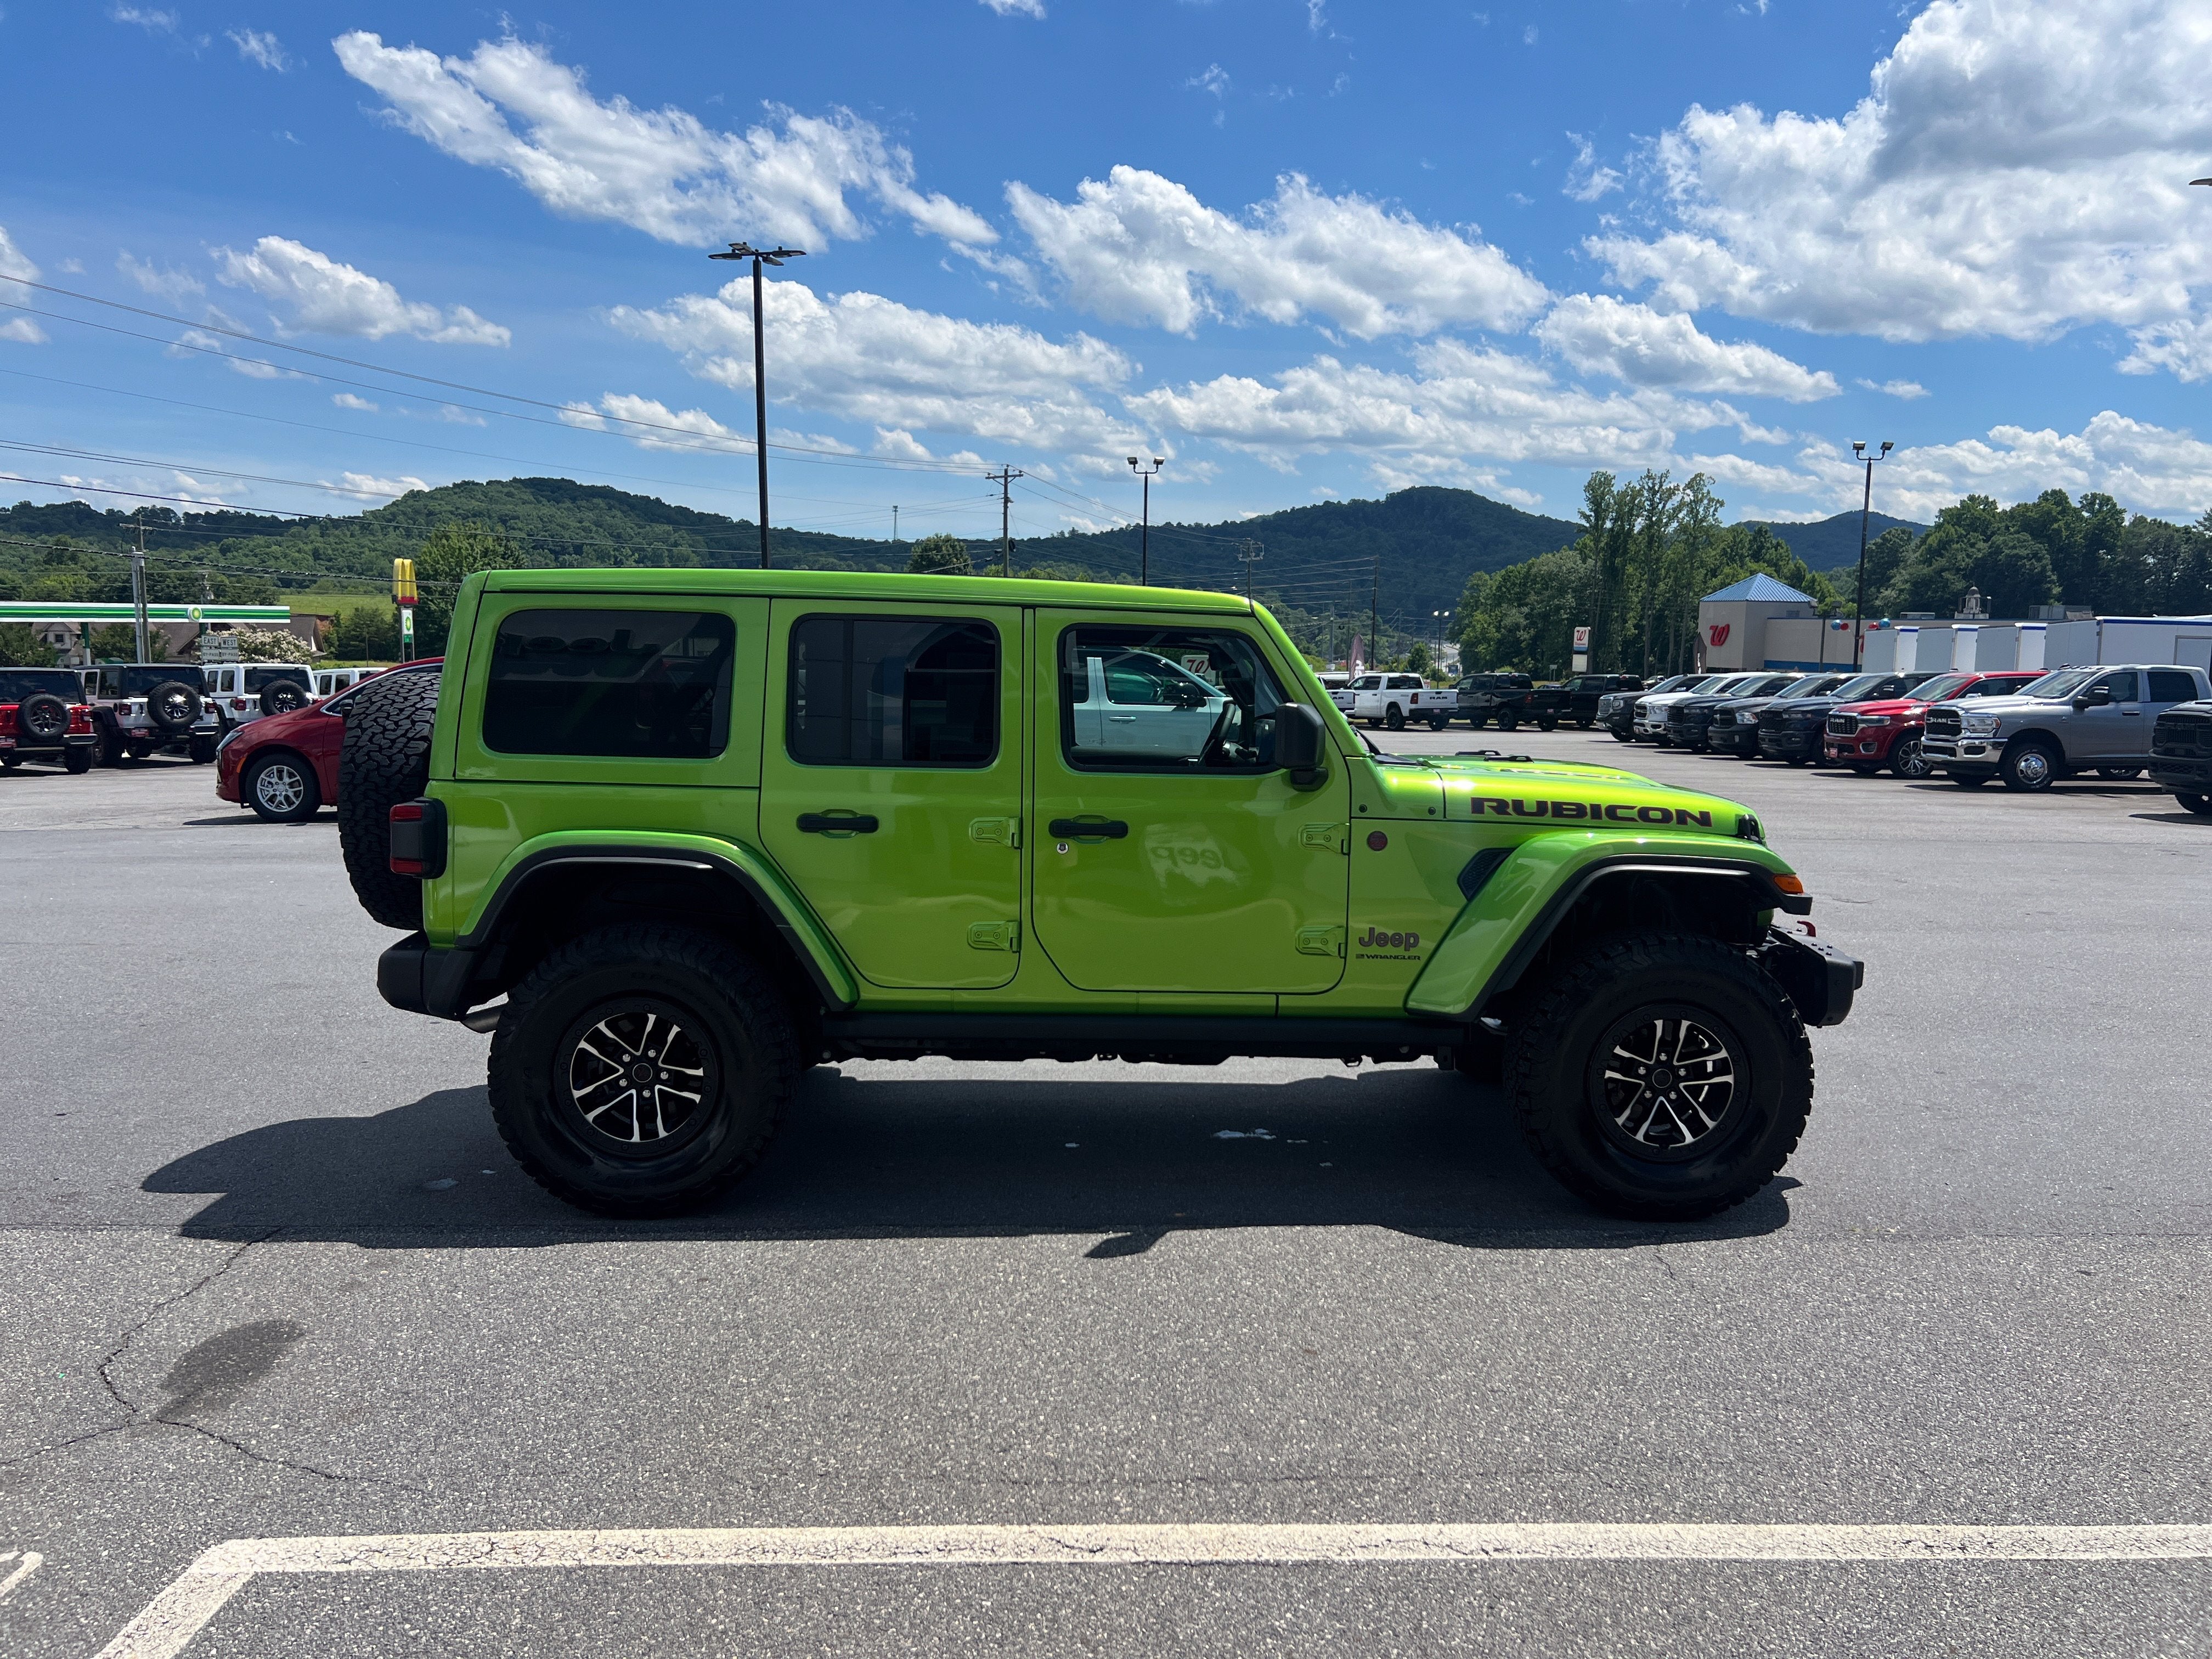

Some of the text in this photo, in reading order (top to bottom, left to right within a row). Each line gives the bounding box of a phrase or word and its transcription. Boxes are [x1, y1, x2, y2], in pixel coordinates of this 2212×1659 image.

[1576, 629, 1587, 641] W
[1709, 623, 1730, 646] W
[1470, 797, 1713, 827] RUBICON
[1358, 927, 1420, 951] Jeep
